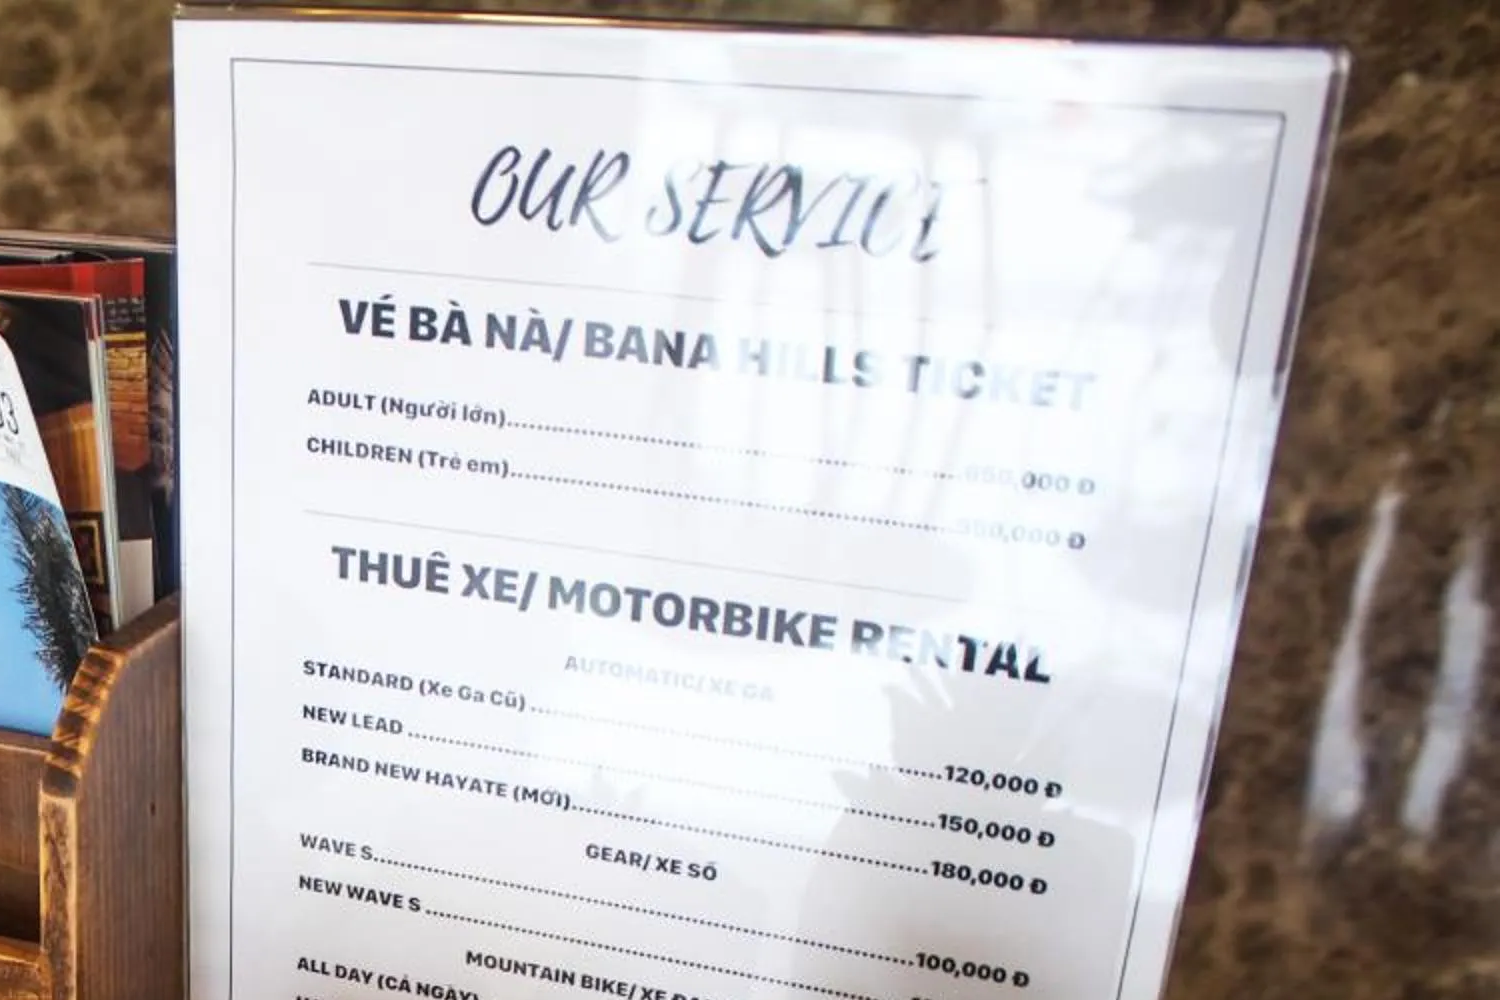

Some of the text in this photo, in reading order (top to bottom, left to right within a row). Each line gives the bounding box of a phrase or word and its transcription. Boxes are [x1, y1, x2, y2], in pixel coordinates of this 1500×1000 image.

[471, 145, 630, 243] OUR
[338, 294, 396, 339] VÉ
[408, 301, 472, 346] BÀ
[584, 321, 721, 371] BANA
[307, 388, 376, 412] ADULT
[381, 397, 457, 421] (Người
[306, 436, 413, 465] CHILDREN
[418, 450, 462, 471] (Trẻ
[466, 459, 510, 479] em)
[331, 545, 1052, 685] THUÊ XE/ MOTORBIKE RENTAL
[303, 659, 413, 692] STANDARD
[419, 678, 453, 698] (Xe
[458, 685, 485, 703] Ga
[944, 765, 1039, 796] 120,000
[302, 704, 347, 726] NEW
[351, 713, 403, 735] LEAD
[937, 813, 1031, 844] 150,000
[301, 748, 371, 774] BRAND
[374, 762, 421, 783] NEW
[425, 770, 509, 798] HAYATE
[930, 860, 1024, 892] 180,000
[298, 875, 343, 896] NEW
[347, 884, 404, 909] WAVE
[408, 897, 421, 913] S
[585, 843, 651, 872] GEAR/
[656, 857, 683, 876] XE
[299, 832, 357, 858] WAVE
[360, 845, 374, 862] S
[915, 952, 1007, 984] 100,000
[297, 957, 331, 976] ALL
[334, 964, 374, 985] DAY
[465, 950, 575, 986] MOUNTAIN
[580, 975, 637, 1000] BIKE/
